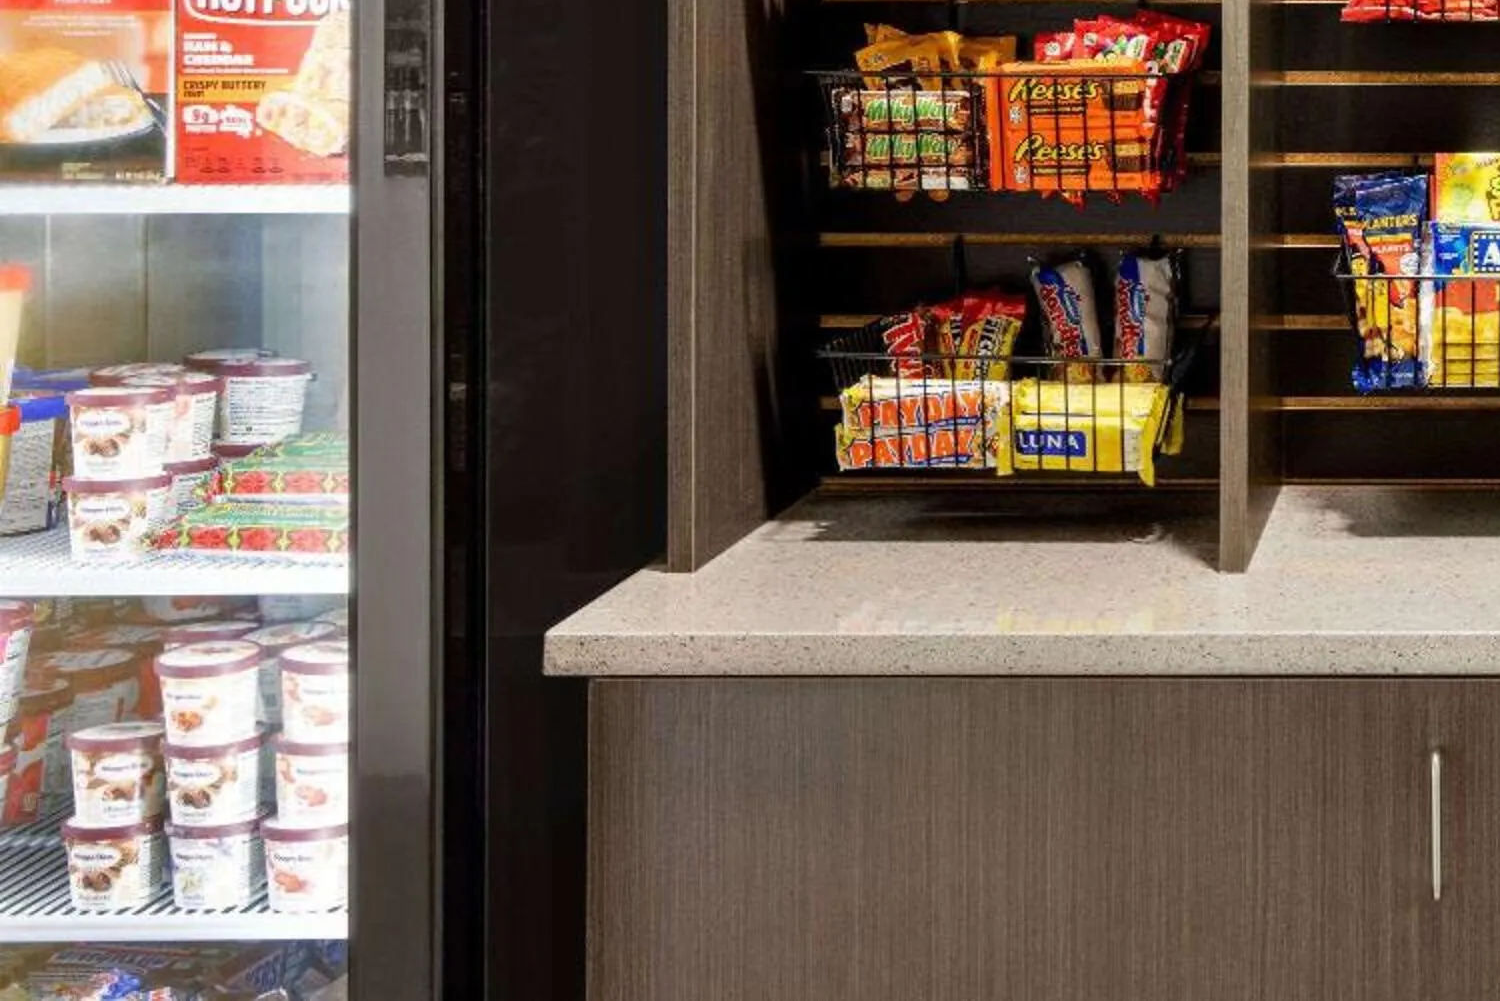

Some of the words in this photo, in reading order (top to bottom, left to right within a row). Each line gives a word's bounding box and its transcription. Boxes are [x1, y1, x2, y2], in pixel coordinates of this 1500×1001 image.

[184, 81, 218, 90] CRISPY
[221, 81, 266, 90] BUTTERY
[1009, 77, 1100, 102] Reese's
[1014, 134, 1104, 161] Reese's
[1366, 215, 1418, 230] LANTERS
[1018, 431, 1080, 451] LUNA
